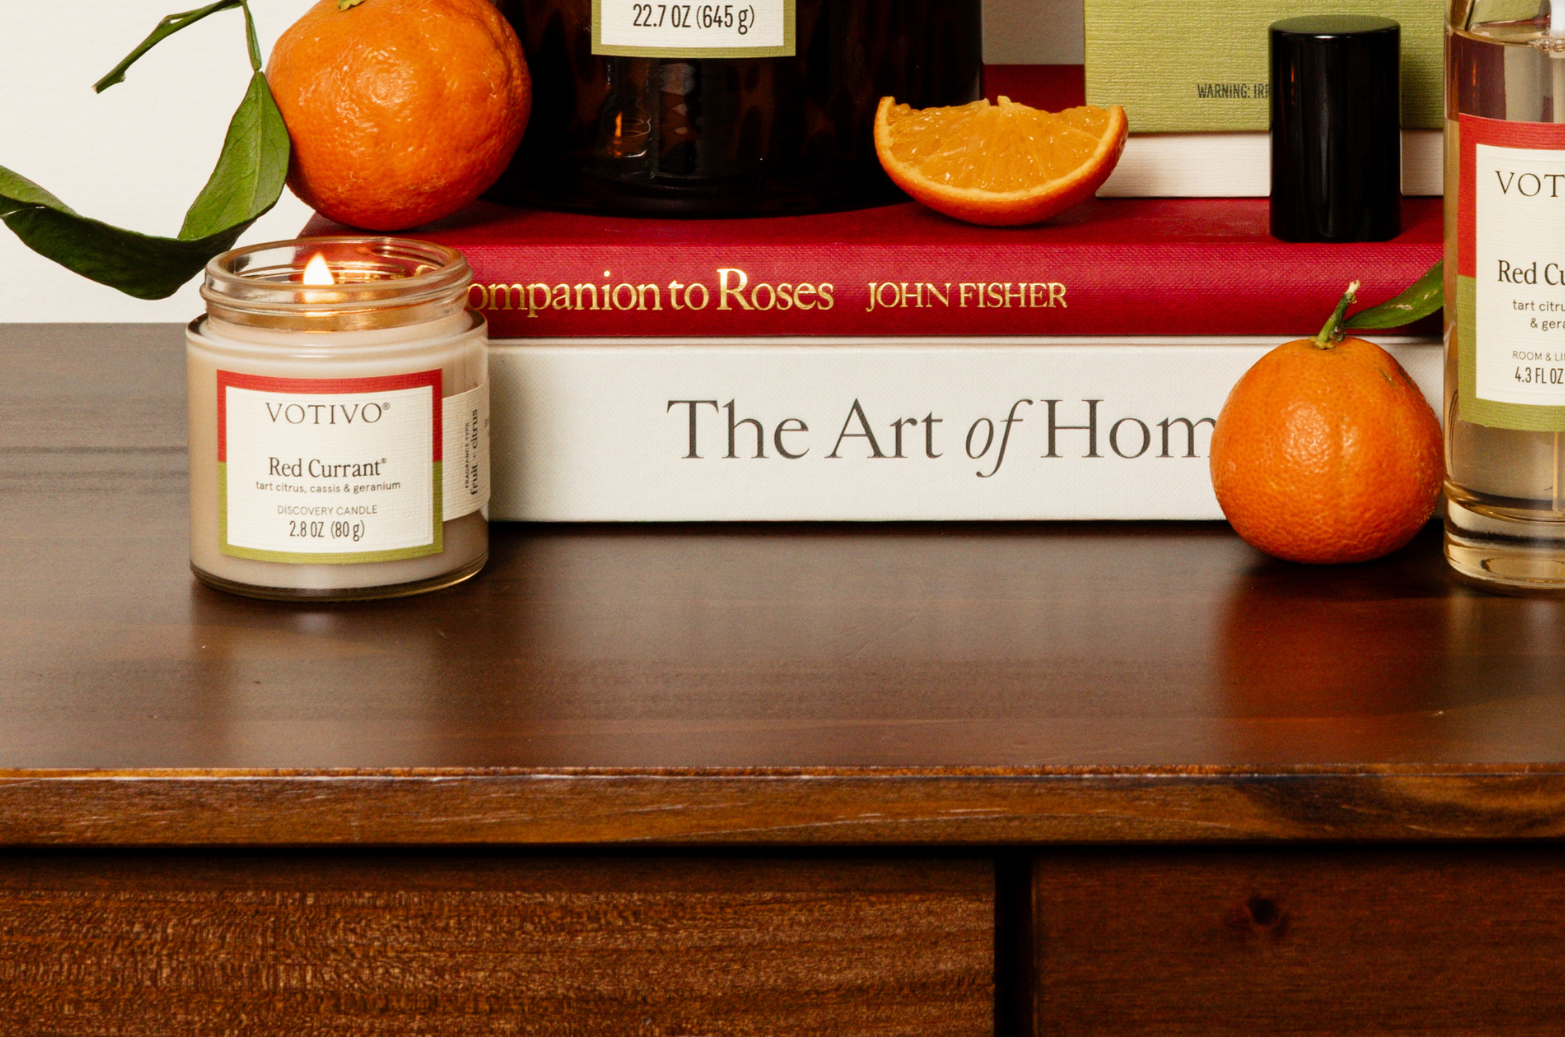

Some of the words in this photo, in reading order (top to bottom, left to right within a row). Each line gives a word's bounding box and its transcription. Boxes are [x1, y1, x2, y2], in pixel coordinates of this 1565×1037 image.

[632, 3, 667, 28] 22.7
[670, 4, 692, 29] OZ
[695, 4, 734, 30] (645
[737, 4, 756, 36] g)
[1196, 82, 1251, 99] WARNING:
[1497, 259, 1538, 285] Red
[668, 280, 711, 312] to
[716, 266, 836, 312] Roses
[865, 281, 953, 314] JOHN
[959, 281, 1069, 310] FISHER
[1512, 299, 1535, 312] tart
[1529, 317, 1538, 329] &
[1512, 350, 1543, 361] ROOM
[1545, 351, 1552, 362] &
[1514, 366, 1532, 384] 4.3
[1535, 367, 1548, 385] FL
[1549, 367, 1564, 385] OZ
[470, 408, 479, 450] citrus
[666, 398, 810, 460] The
[823, 397, 944, 460] Art
[965, 398, 1034, 479] of
[268, 456, 303, 478] Red
[255, 480, 273, 492] tart
[275, 482, 307, 495] citrus,
[309, 483, 341, 494] cassis
[343, 483, 351, 494] &
[353, 480, 401, 495] geranium
[470, 464, 479, 496] fruit
[277, 505, 334, 516] DISCOVERY
[335, 504, 378, 516] CANDLE
[289, 520, 307, 538] 2.8
[310, 520, 325, 538] OZ
[330, 520, 350, 539] (80
[352, 519, 365, 543] g)
